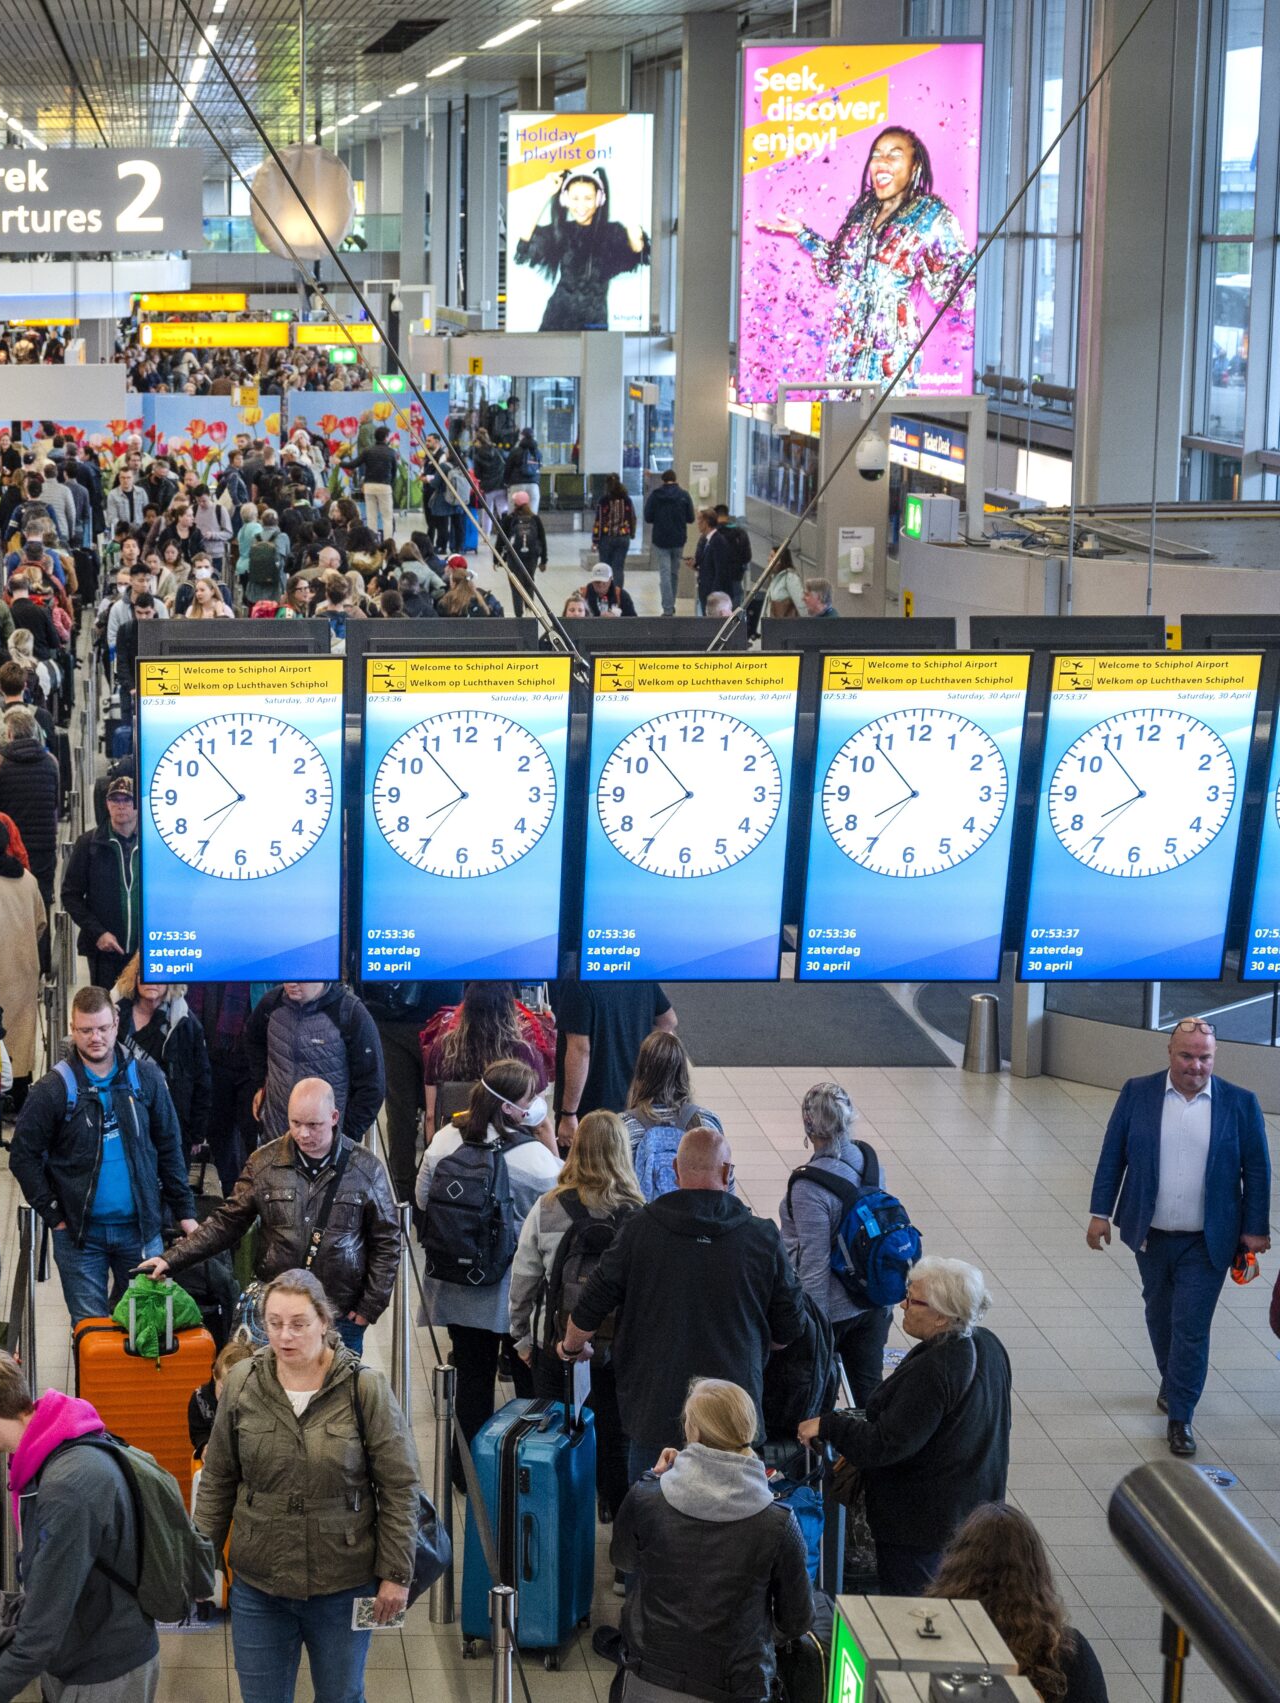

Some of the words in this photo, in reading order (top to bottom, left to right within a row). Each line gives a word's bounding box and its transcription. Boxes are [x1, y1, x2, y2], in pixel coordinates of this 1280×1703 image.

[753, 65, 824, 94] Seek,
[767, 96, 885, 124] discover,
[516, 128, 577, 145] Holiday
[752, 126, 837, 164] enjoy!
[524, 146, 581, 164] playlist
[586, 147, 612, 159] on!
[116, 159, 164, 233] 2
[473, 360, 479, 373] F
[227, 666, 236, 674] to
[239, 666, 277, 675] Schiphol
[279, 666, 312, 675] Airport
[466, 663, 504, 671] Schiphol
[506, 662, 539, 671] Airport
[694, 662, 732, 671] Schiphol
[735, 662, 768, 671] Airport
[924, 661, 962, 669] Schiphol
[965, 661, 998, 669] Airport
[1099, 661, 1140, 669] Welcome
[1154, 661, 1193, 670] Schiphol
[1196, 661, 1229, 669] Airport
[184, 682, 220, 690] Welkom
[223, 683, 234, 691] op
[237, 681, 288, 690] Luchthaven
[290, 681, 328, 690] Schiphol
[410, 679, 446, 687] Welkom
[450, 680, 461, 688] op
[463, 678, 515, 686] Luchthaven
[517, 678, 555, 687] Schiphol
[638, 678, 674, 686] Welkom
[677, 679, 688, 687] op
[691, 677, 743, 686] Luchthaven
[746, 677, 784, 686] Schiphol
[906, 678, 917, 686] op
[920, 676, 972, 684] Luchthaven
[975, 676, 1013, 685] Schiphol
[1136, 678, 1148, 686] op
[1150, 676, 1203, 684] Luchthaven
[1205, 676, 1244, 685] Schiphol
[317, 696, 337, 704] April
[543, 693, 563, 702] April
[771, 692, 791, 701] April
[1000, 691, 1021, 700] April
[1230, 691, 1251, 700] April
[228, 729, 253, 746] 12
[195, 738, 215, 754] 11
[269, 738, 277, 754] 1
[174, 760, 199, 777] 10
[293, 758, 306, 774] 2
[165, 790, 177, 805] 9
[305, 789, 317, 805] 3
[175, 818, 187, 834] 8
[292, 820, 304, 835] 4
[198, 840, 210, 856] 7
[270, 841, 281, 856] 5
[235, 849, 247, 865] 6
[149, 931, 197, 941] 07:53:36
[367, 929, 415, 939] 07:53:36
[588, 929, 636, 939] 07:53:36
[808, 929, 856, 939] 07:53:36
[1031, 929, 1080, 938] 07:53:37
[1255, 929, 1280, 938] 07:5
[149, 947, 202, 958] zaterdag
[367, 945, 420, 957] zaterdag
[587, 945, 641, 957] zaterdag
[807, 945, 860, 957] zaterdag
[1029, 945, 1083, 957] zaterdag
[1252, 946, 1280, 954] zate
[149, 963, 163, 973] 30
[166, 963, 193, 974] april
[367, 962, 381, 971] 30
[383, 961, 411, 973] april
[586, 962, 600, 971] 30
[603, 961, 631, 973] april
[806, 961, 819, 971] 30
[822, 961, 851, 972] april
[1027, 961, 1042, 971] 30
[1044, 961, 1072, 972] april
[1251, 961, 1264, 971] 30
